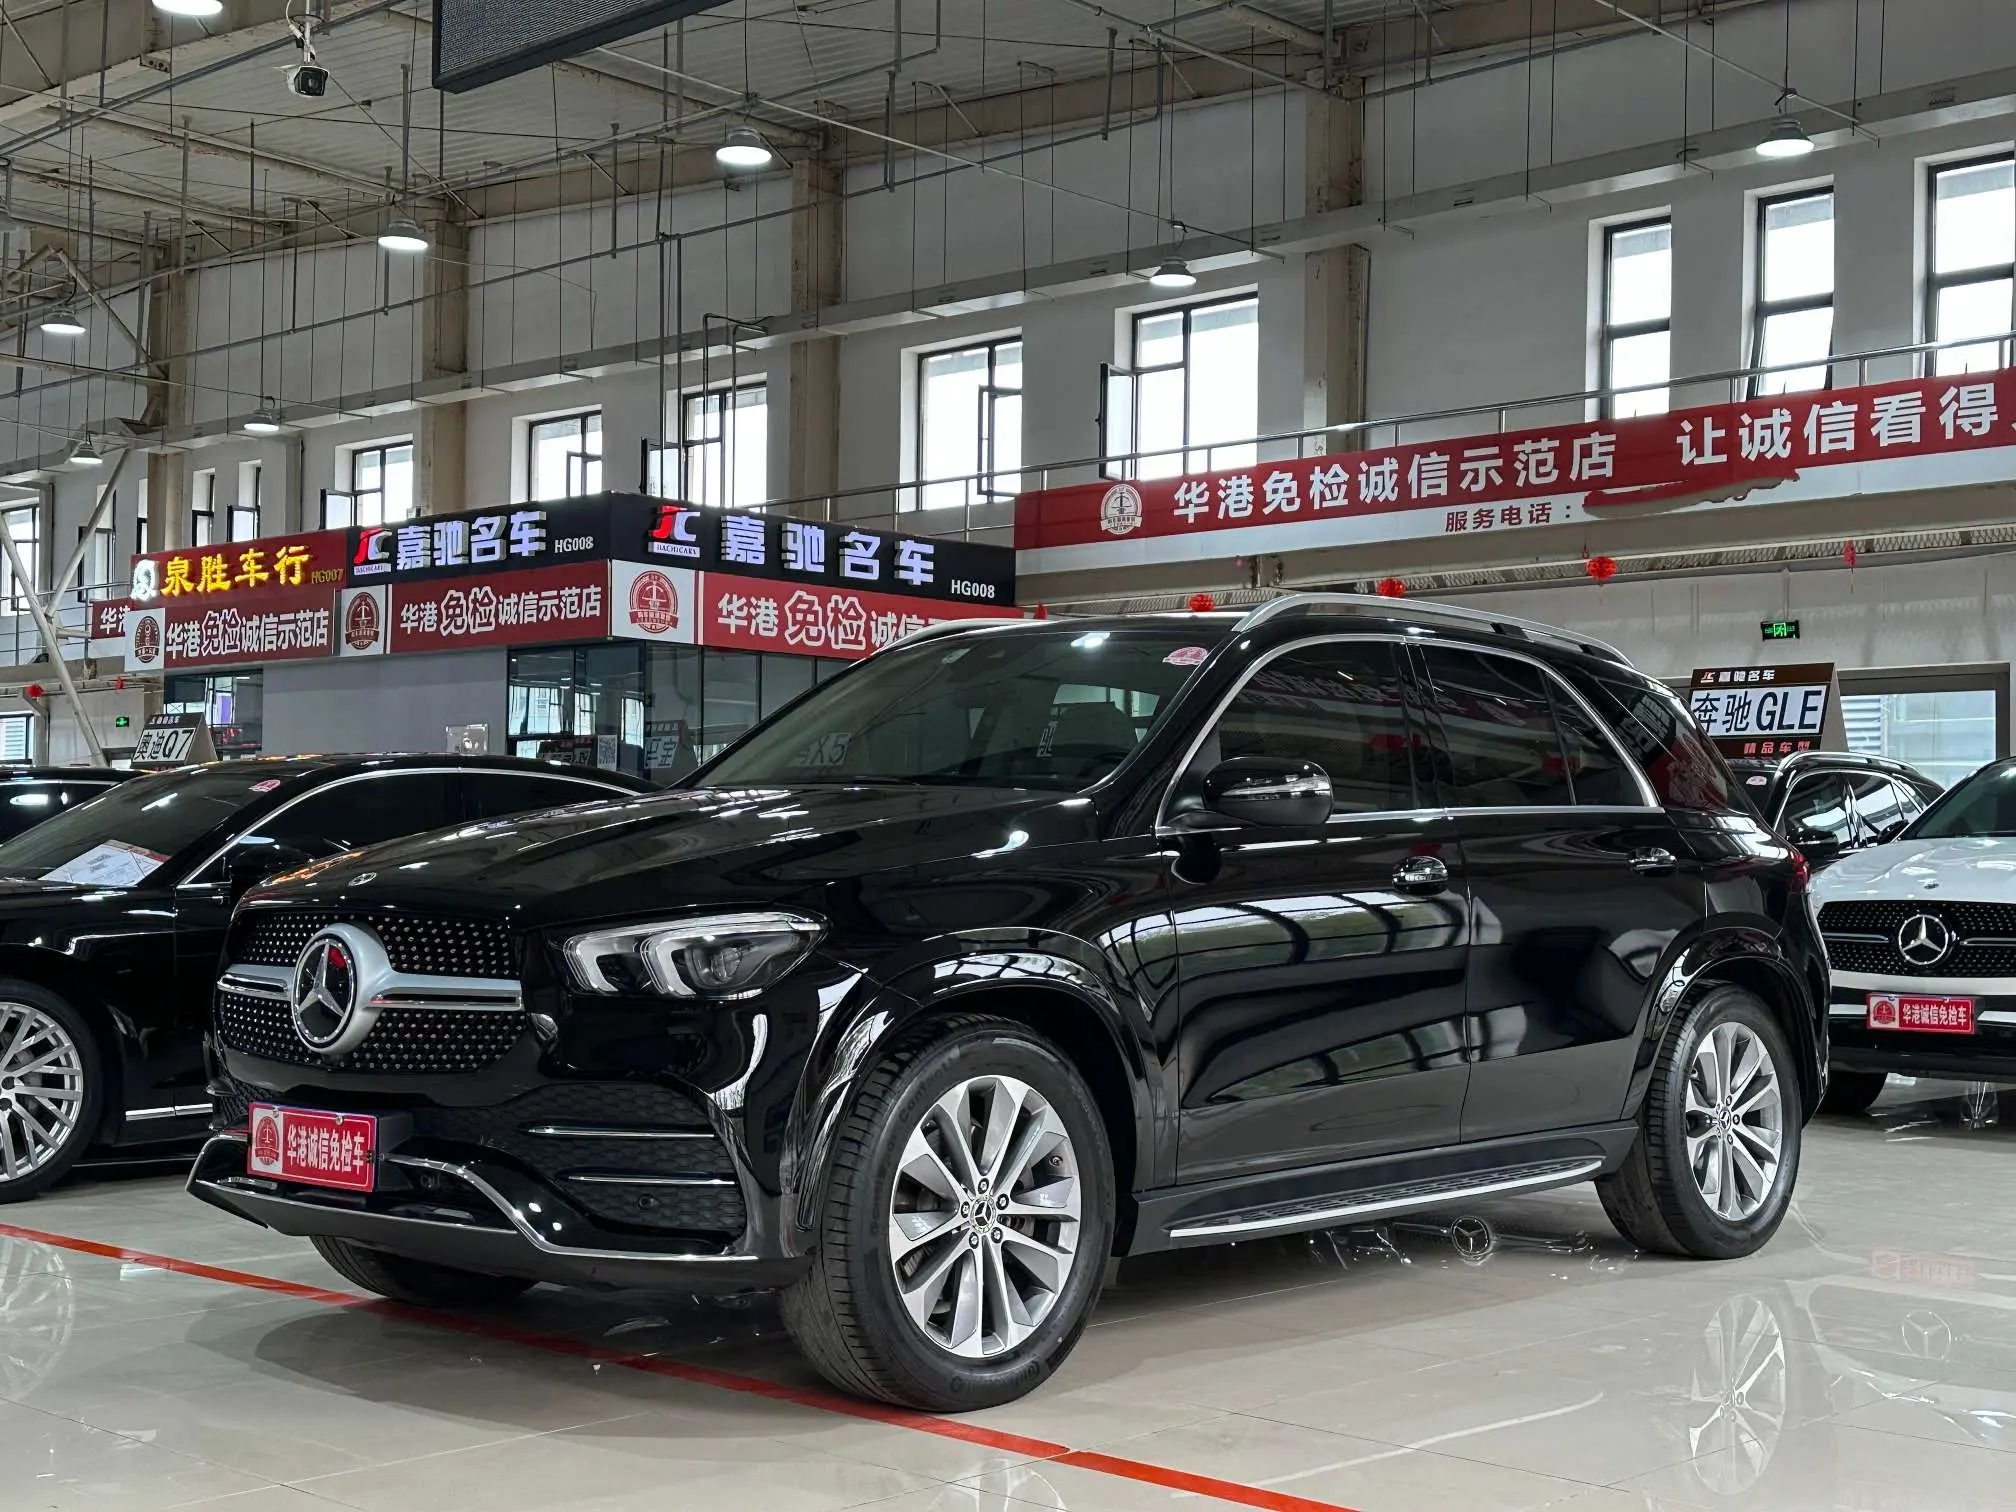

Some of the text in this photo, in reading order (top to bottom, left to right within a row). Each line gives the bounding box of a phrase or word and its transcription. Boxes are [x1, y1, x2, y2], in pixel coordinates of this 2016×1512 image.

[1173, 432, 1617, 524] 华港免检诚信示范店
[1676, 383, 2016, 466] 让诚信看得
[396, 511, 547, 570] 嘉驰名车
[554, 536, 594, 554] HG008
[720, 514, 935, 586] 嘉驰名车
[160, 545, 311, 597] 泉胜车行
[311, 568, 344, 584] HG007
[951, 579, 996, 599] HG008
[166, 607, 329, 660] 华港免检诚信示范店
[400, 584, 602, 637] 华港免检诚信示范店
[717, 590, 949, 652] 华港免检诚信
[1902, 1003, 1967, 1026] 华港诚信免检车
[287, 1123, 365, 1175] 华港诚信免检车
